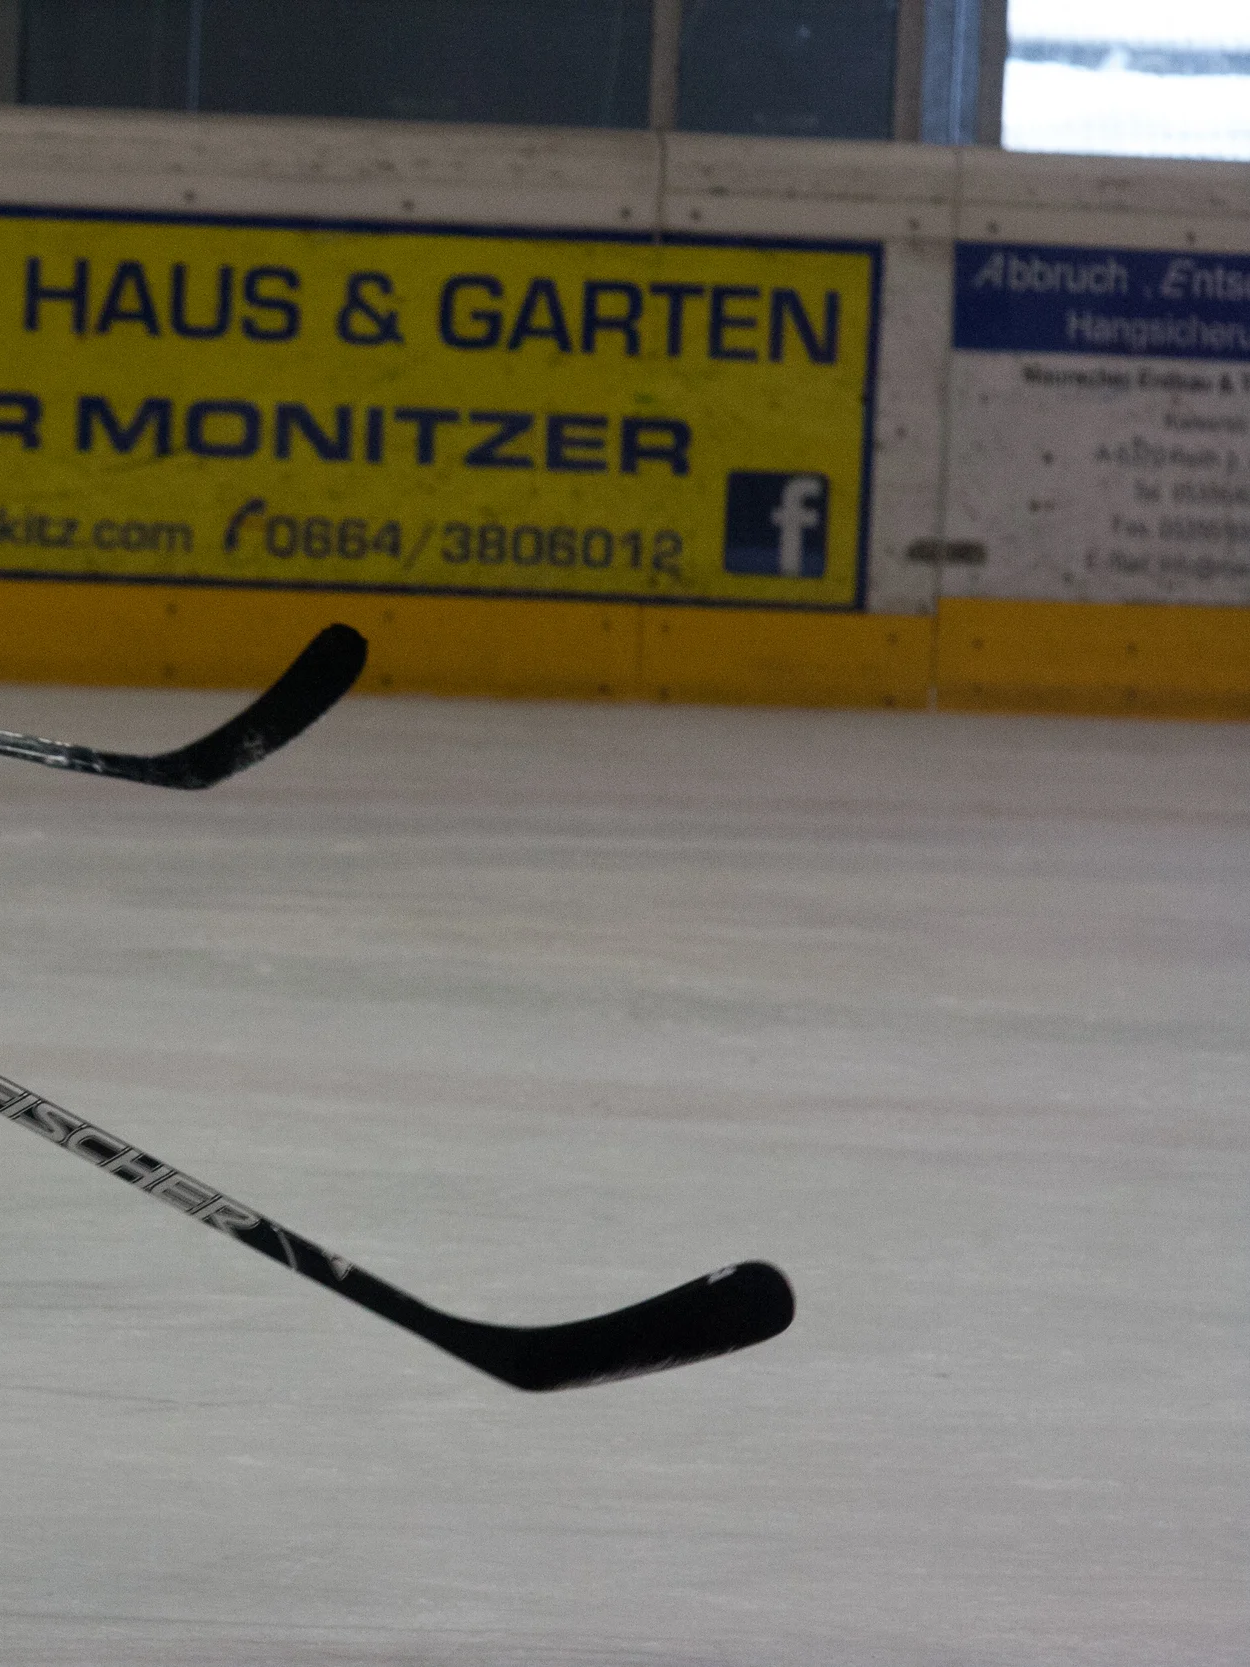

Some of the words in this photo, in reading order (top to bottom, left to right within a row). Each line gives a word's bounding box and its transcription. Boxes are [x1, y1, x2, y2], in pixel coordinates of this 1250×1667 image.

[24, 255, 301, 344] HAUS
[336, 271, 404, 346] &
[438, 273, 842, 366] GARTEN
[75, 394, 693, 476] MONITZER
